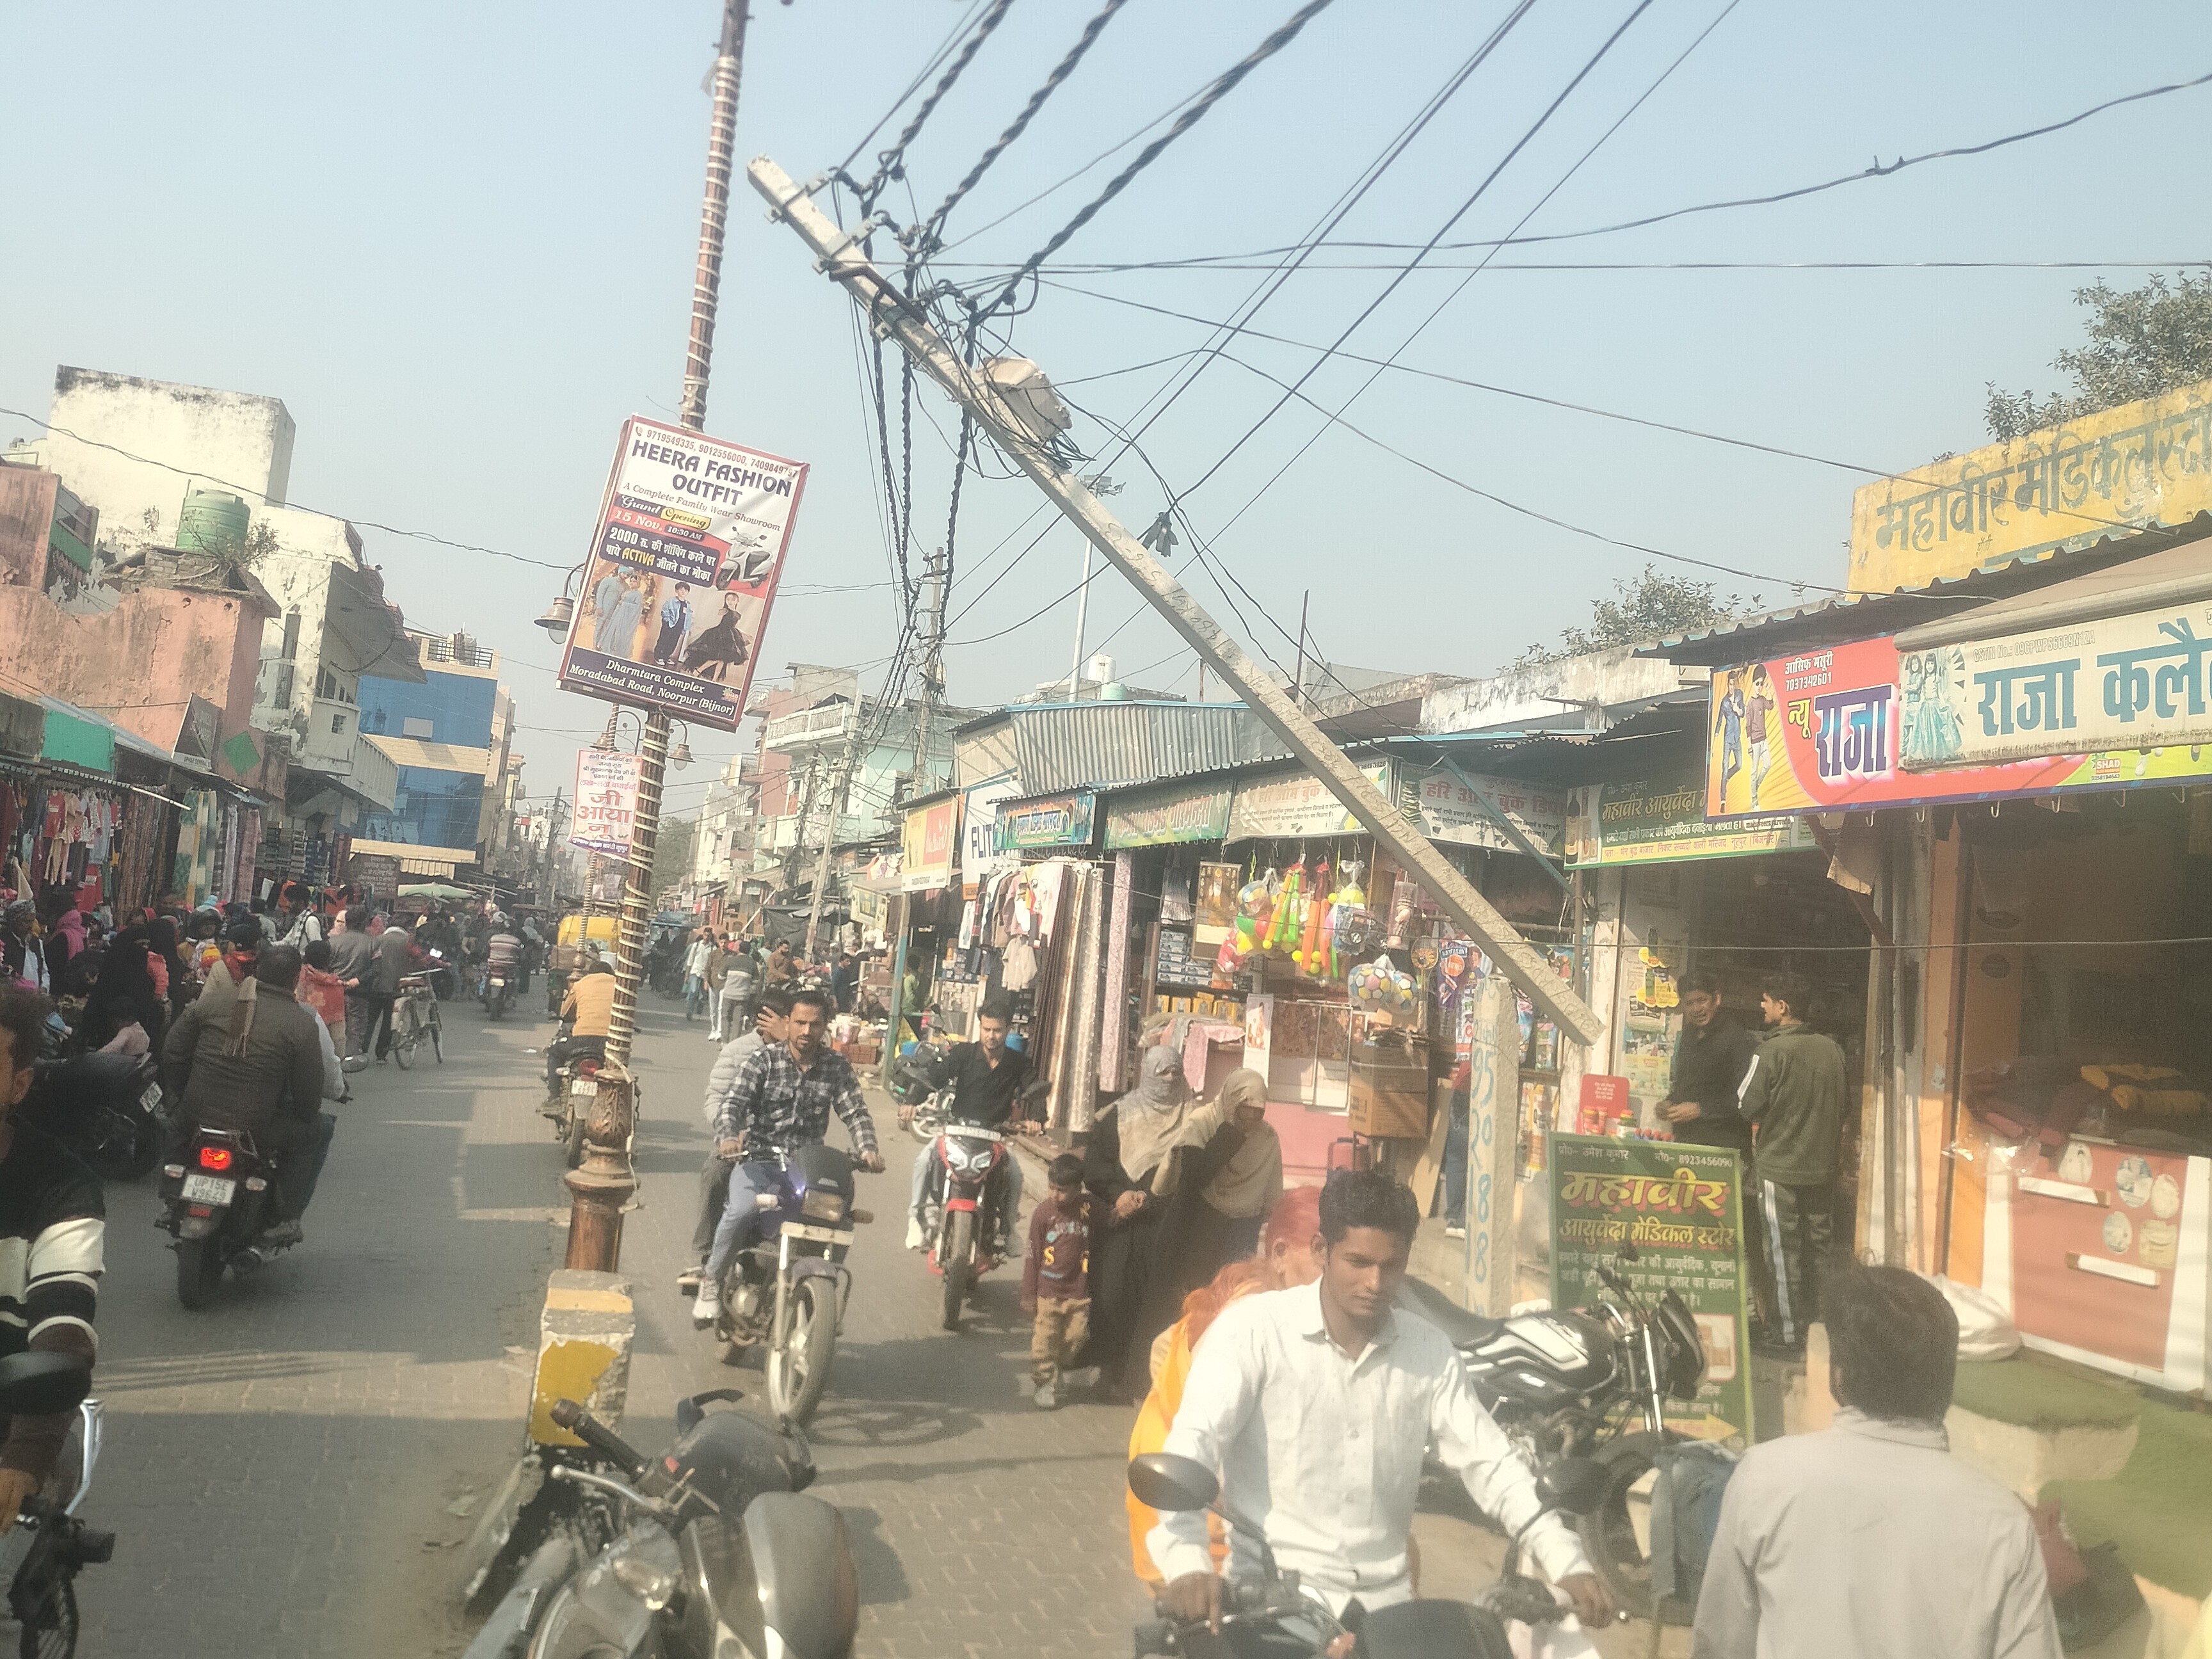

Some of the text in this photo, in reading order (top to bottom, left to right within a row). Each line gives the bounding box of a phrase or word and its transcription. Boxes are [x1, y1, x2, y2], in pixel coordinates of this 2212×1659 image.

[632, 440, 792, 497] HEERA FASHION
[673, 474, 742, 505] OUTFIT
[621, 495, 706, 528] Grand Opening
[633, 485, 675, 502] Complete
[677, 497, 707, 512] Family
[710, 506, 732, 517] Wear
[734, 513, 780, 531] Showroom
[614, 510, 703, 540] 15 Nov. 10:30 AM
[609, 527, 639, 545] 2000
[652, 539, 663, 551] की
[688, 549, 705, 563] करने
[707, 556, 716, 567] पर
[621, 547, 655, 566] ACTIVA
[680, 565, 690, 575] का
[1784, 658, 1811, 675] आसिफ
[1974, 646, 1996, 662] GSTIN
[569, 664, 735, 716] Moradabad Road, Noorpur (Bijnor)
[606, 659, 705, 694] Dharmtara Complex
[1785, 673, 1832, 692] 7037342601
[1974, 616, 2212, 737] राजा कलै
[1788, 684, 1893, 778] न्यू राजा
[2096, 760, 2120, 769] SHAD
[589, 789, 623, 806] जी
[1427, 781, 1452, 799] हरि
[1603, 793, 1643, 821] महावीर
[1646, 785, 1697, 819] आयुर्वेदा
[577, 806, 632, 823] आया
[1560, 1167, 1727, 1210] महावीर
[1559, 1213, 1736, 1246] आयुर्वेदा मेडिकल स्टोर
